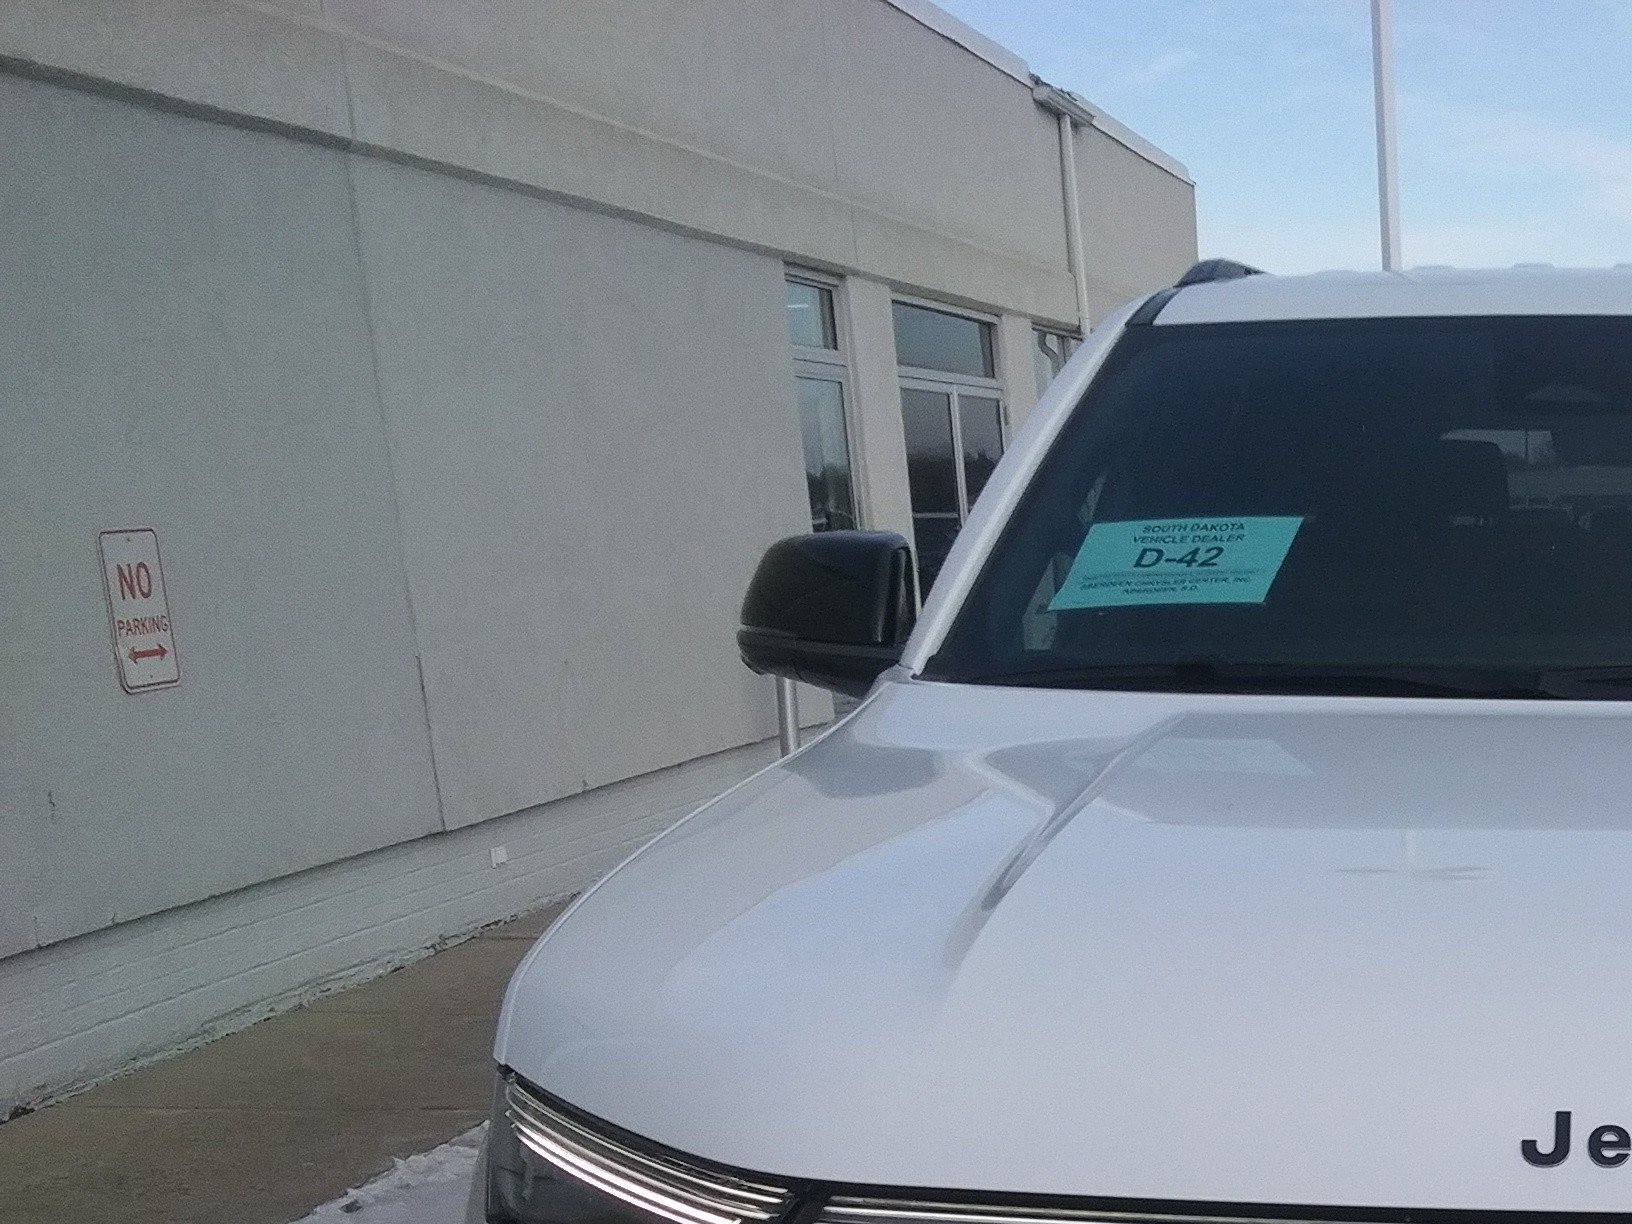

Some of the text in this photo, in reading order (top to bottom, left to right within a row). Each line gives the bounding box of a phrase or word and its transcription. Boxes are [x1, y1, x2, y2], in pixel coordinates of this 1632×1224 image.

[1133, 534, 1245, 544] VEHICLE DEALER
[1142, 523, 1245, 533] SOUTH DAKOTA
[1133, 546, 1224, 568] D-42
[117, 561, 151, 600] NO
[117, 615, 169, 637] PARKING
